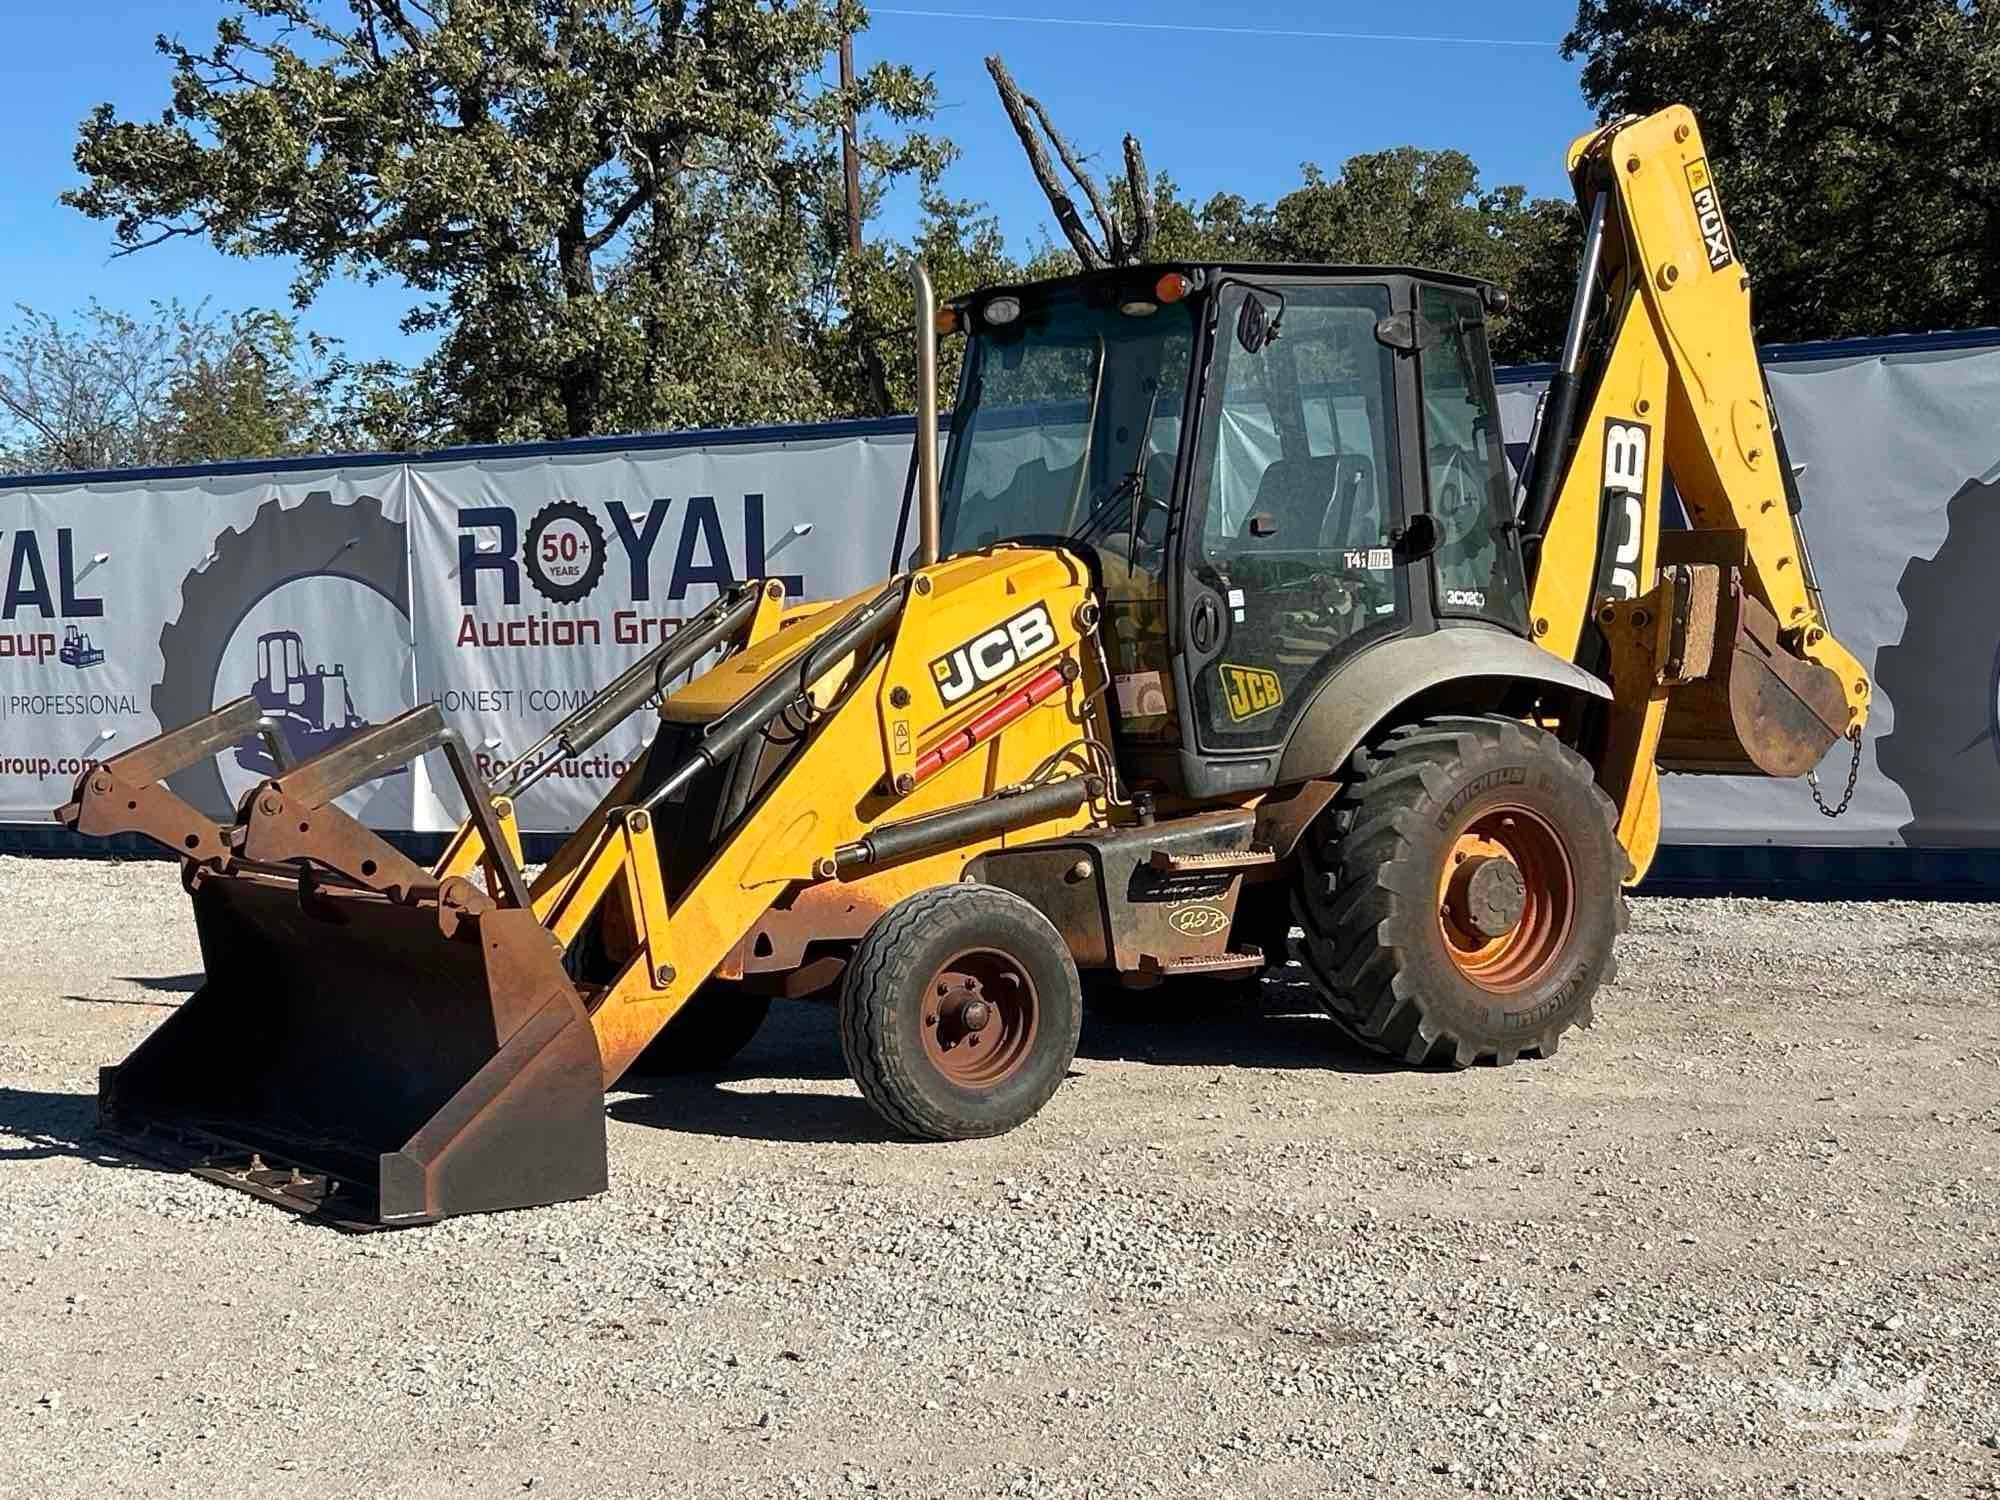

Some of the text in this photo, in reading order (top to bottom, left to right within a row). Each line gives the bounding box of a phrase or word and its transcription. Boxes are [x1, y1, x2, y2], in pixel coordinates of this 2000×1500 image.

[542, 532, 589, 562] 50+
[0, 528, 104, 619] AL
[550, 565, 580, 577] YEARS
[457, 611, 600, 648] Auction
[939, 607, 1055, 702] JCB
[11, 695, 142, 715] PROFESSIONAL
[431, 689, 513, 712] HONEST
[1230, 669, 1280, 715] JCB
[0, 754, 99, 781] roup.com
